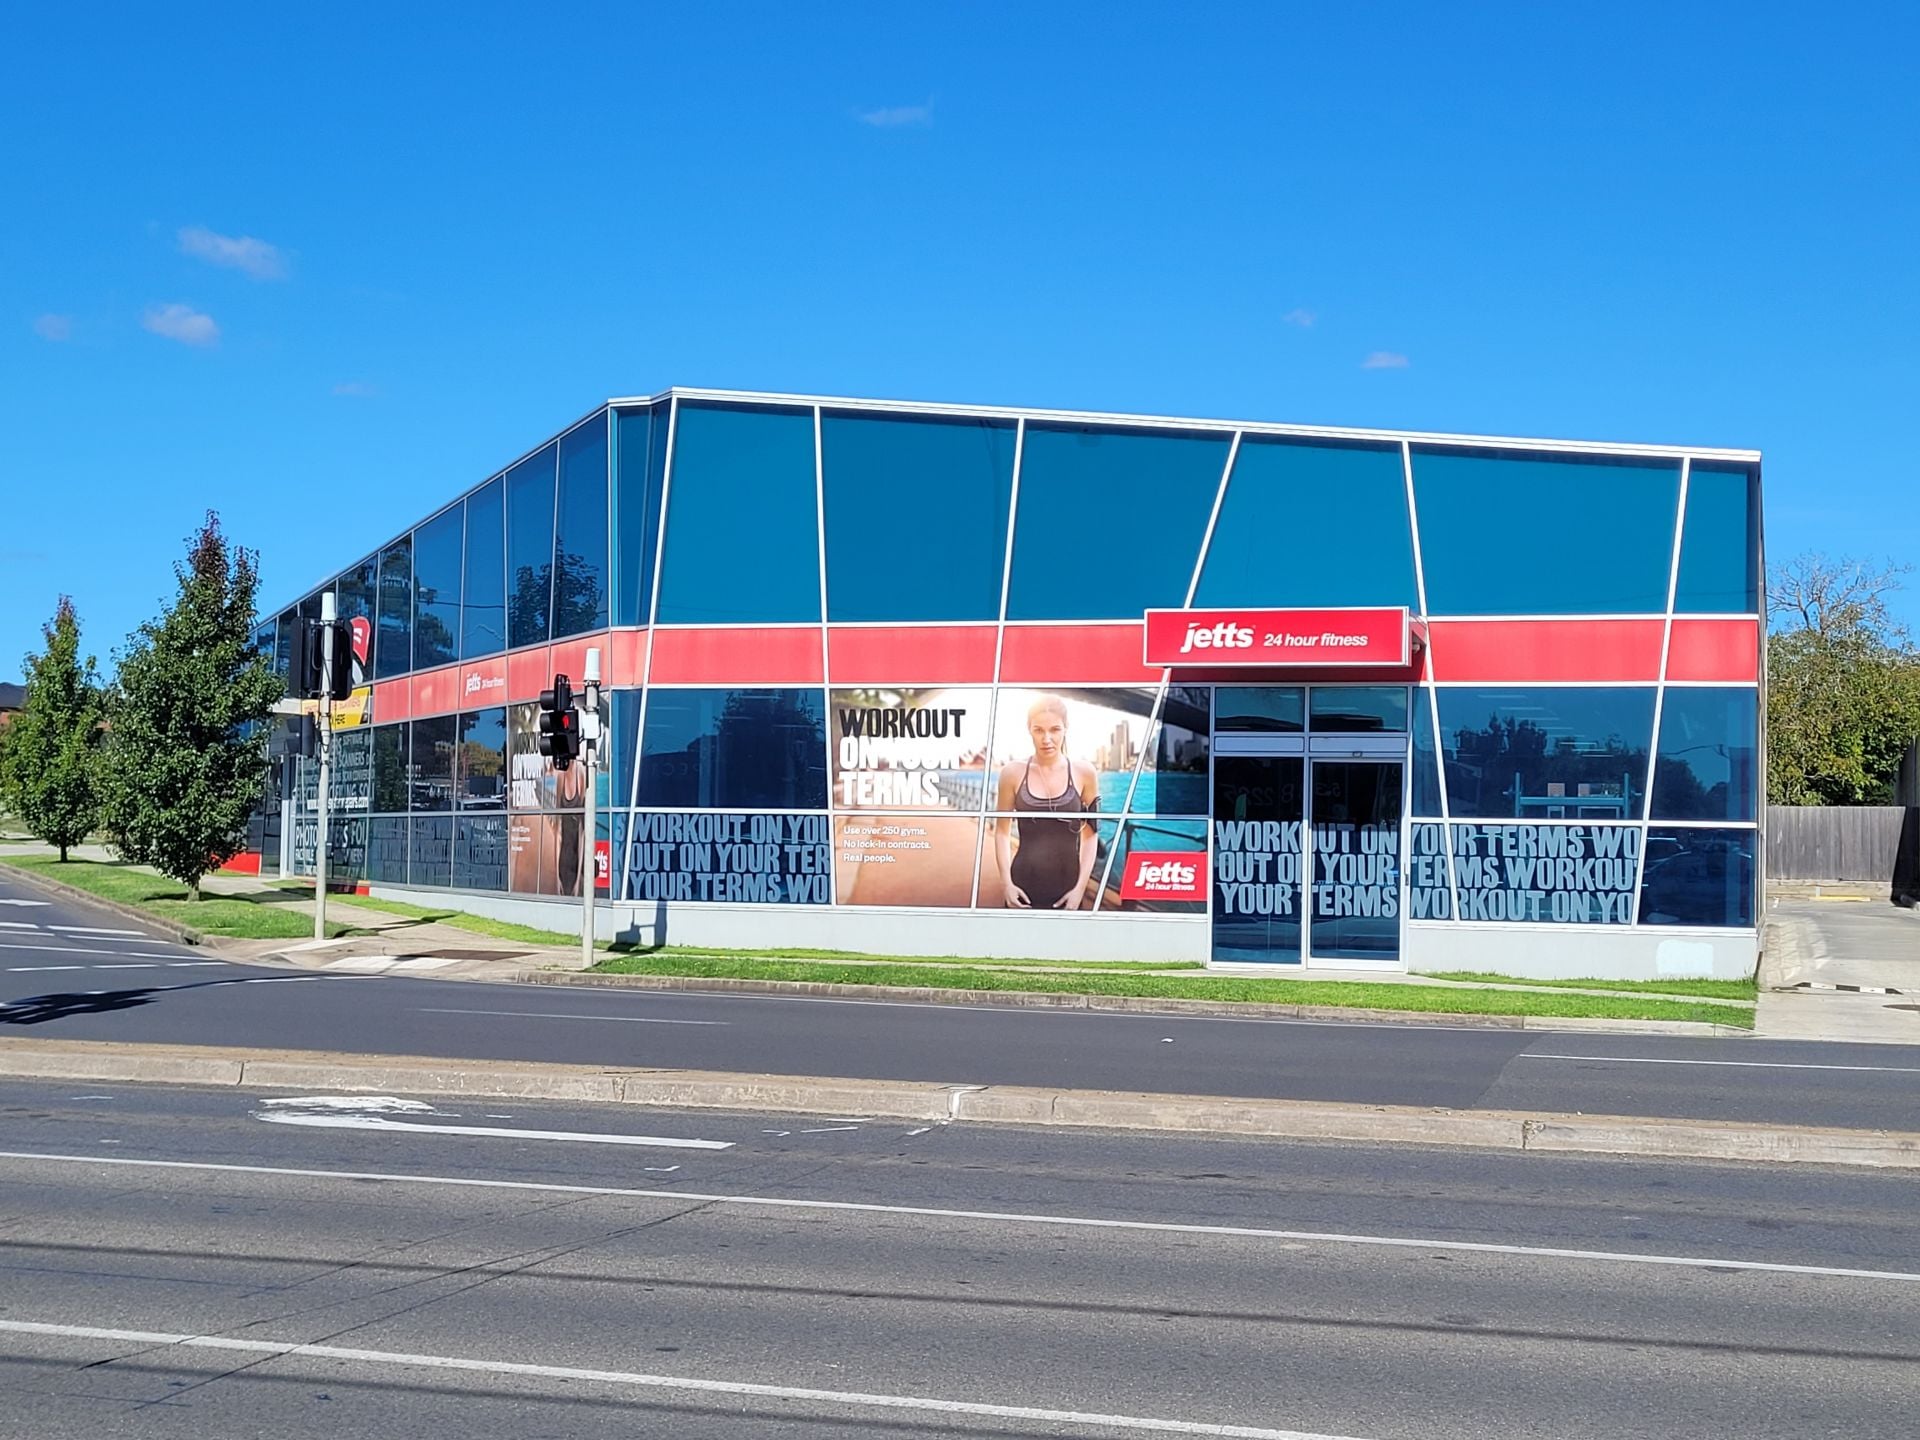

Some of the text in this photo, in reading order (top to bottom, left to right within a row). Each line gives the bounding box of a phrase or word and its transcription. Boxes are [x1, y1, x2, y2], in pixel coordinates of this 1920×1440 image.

[1180, 622, 1368, 653] jetts 24 hour fitness
[839, 708, 967, 739] WORKOUT
[839, 736, 879, 770] ON
[839, 770, 948, 805] TERMS.
[633, 814, 746, 843] WORKOUT
[750, 815, 783, 844] ON
[843, 826, 928, 838] Use over 250 gyms.
[1361, 824, 1397, 854] ON
[1482, 825, 1585, 858] TERMS
[679, 844, 711, 873] ON
[715, 844, 780, 873] YOUR
[843, 839, 931, 850] No lock-in contracts.
[843, 853, 896, 865] Real people.
[1134, 861, 1196, 888] jetts
[1218, 852, 1273, 883] OUT
[1320, 854, 1396, 885] YOUR
[629, 872, 692, 901] YOUR
[696, 873, 782, 902] TERMS
[1219, 882, 1293, 915] YOUR
[1551, 890, 1590, 923] ON
